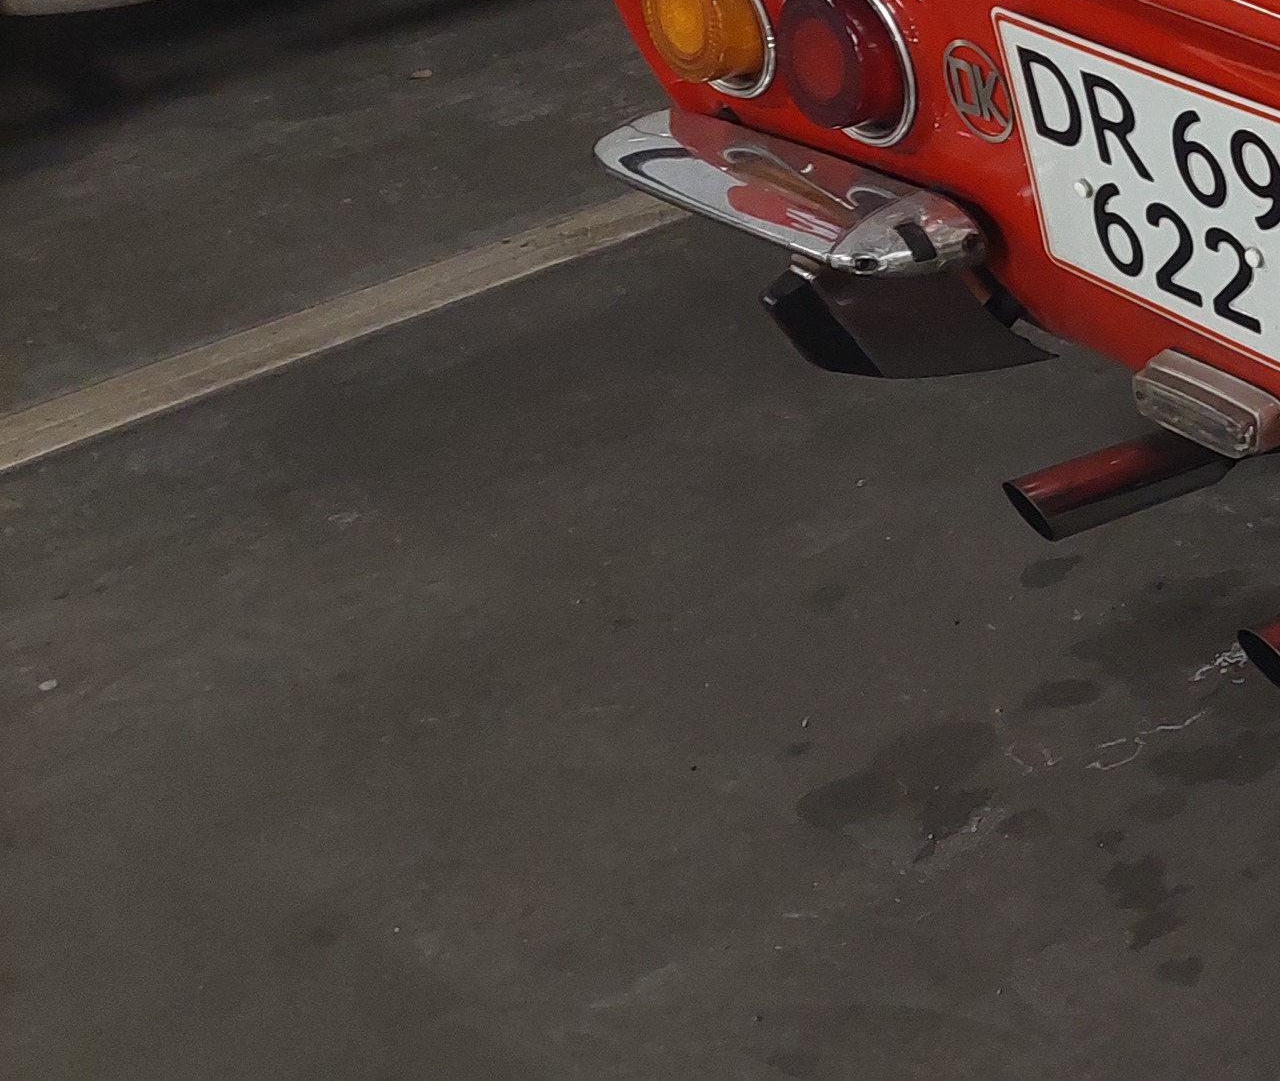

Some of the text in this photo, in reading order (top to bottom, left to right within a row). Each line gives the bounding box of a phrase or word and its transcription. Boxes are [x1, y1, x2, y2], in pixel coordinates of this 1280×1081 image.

[947, 56, 1008, 127] DK
[1016, 45, 1154, 182] DR
[1094, 182, 1262, 334] 622
